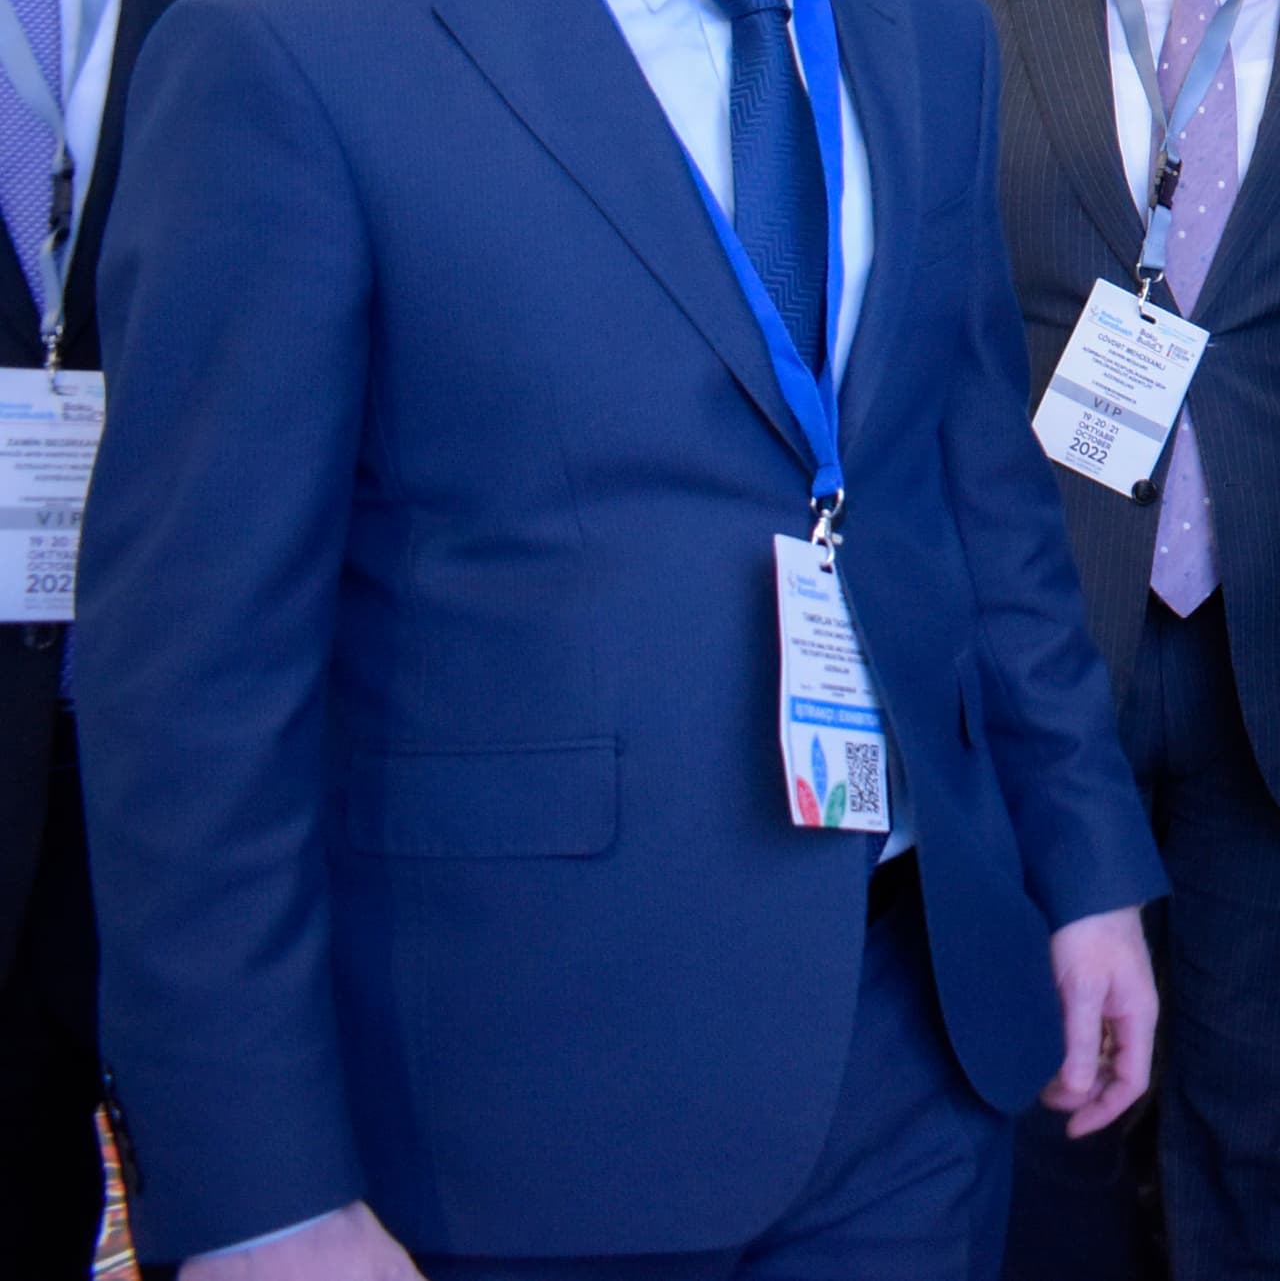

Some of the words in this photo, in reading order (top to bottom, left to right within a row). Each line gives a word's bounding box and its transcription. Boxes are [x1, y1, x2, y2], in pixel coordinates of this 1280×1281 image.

[1093, 397, 1123, 416] VIP
[1083, 411, 1092, 421] 19
[1094, 418, 1107, 429] 20
[1109, 425, 1120, 435] 21
[1075, 429, 1112, 450] OCTOBER
[1069, 437, 1108, 464] 2022
[26, 574, 72, 594] 202
